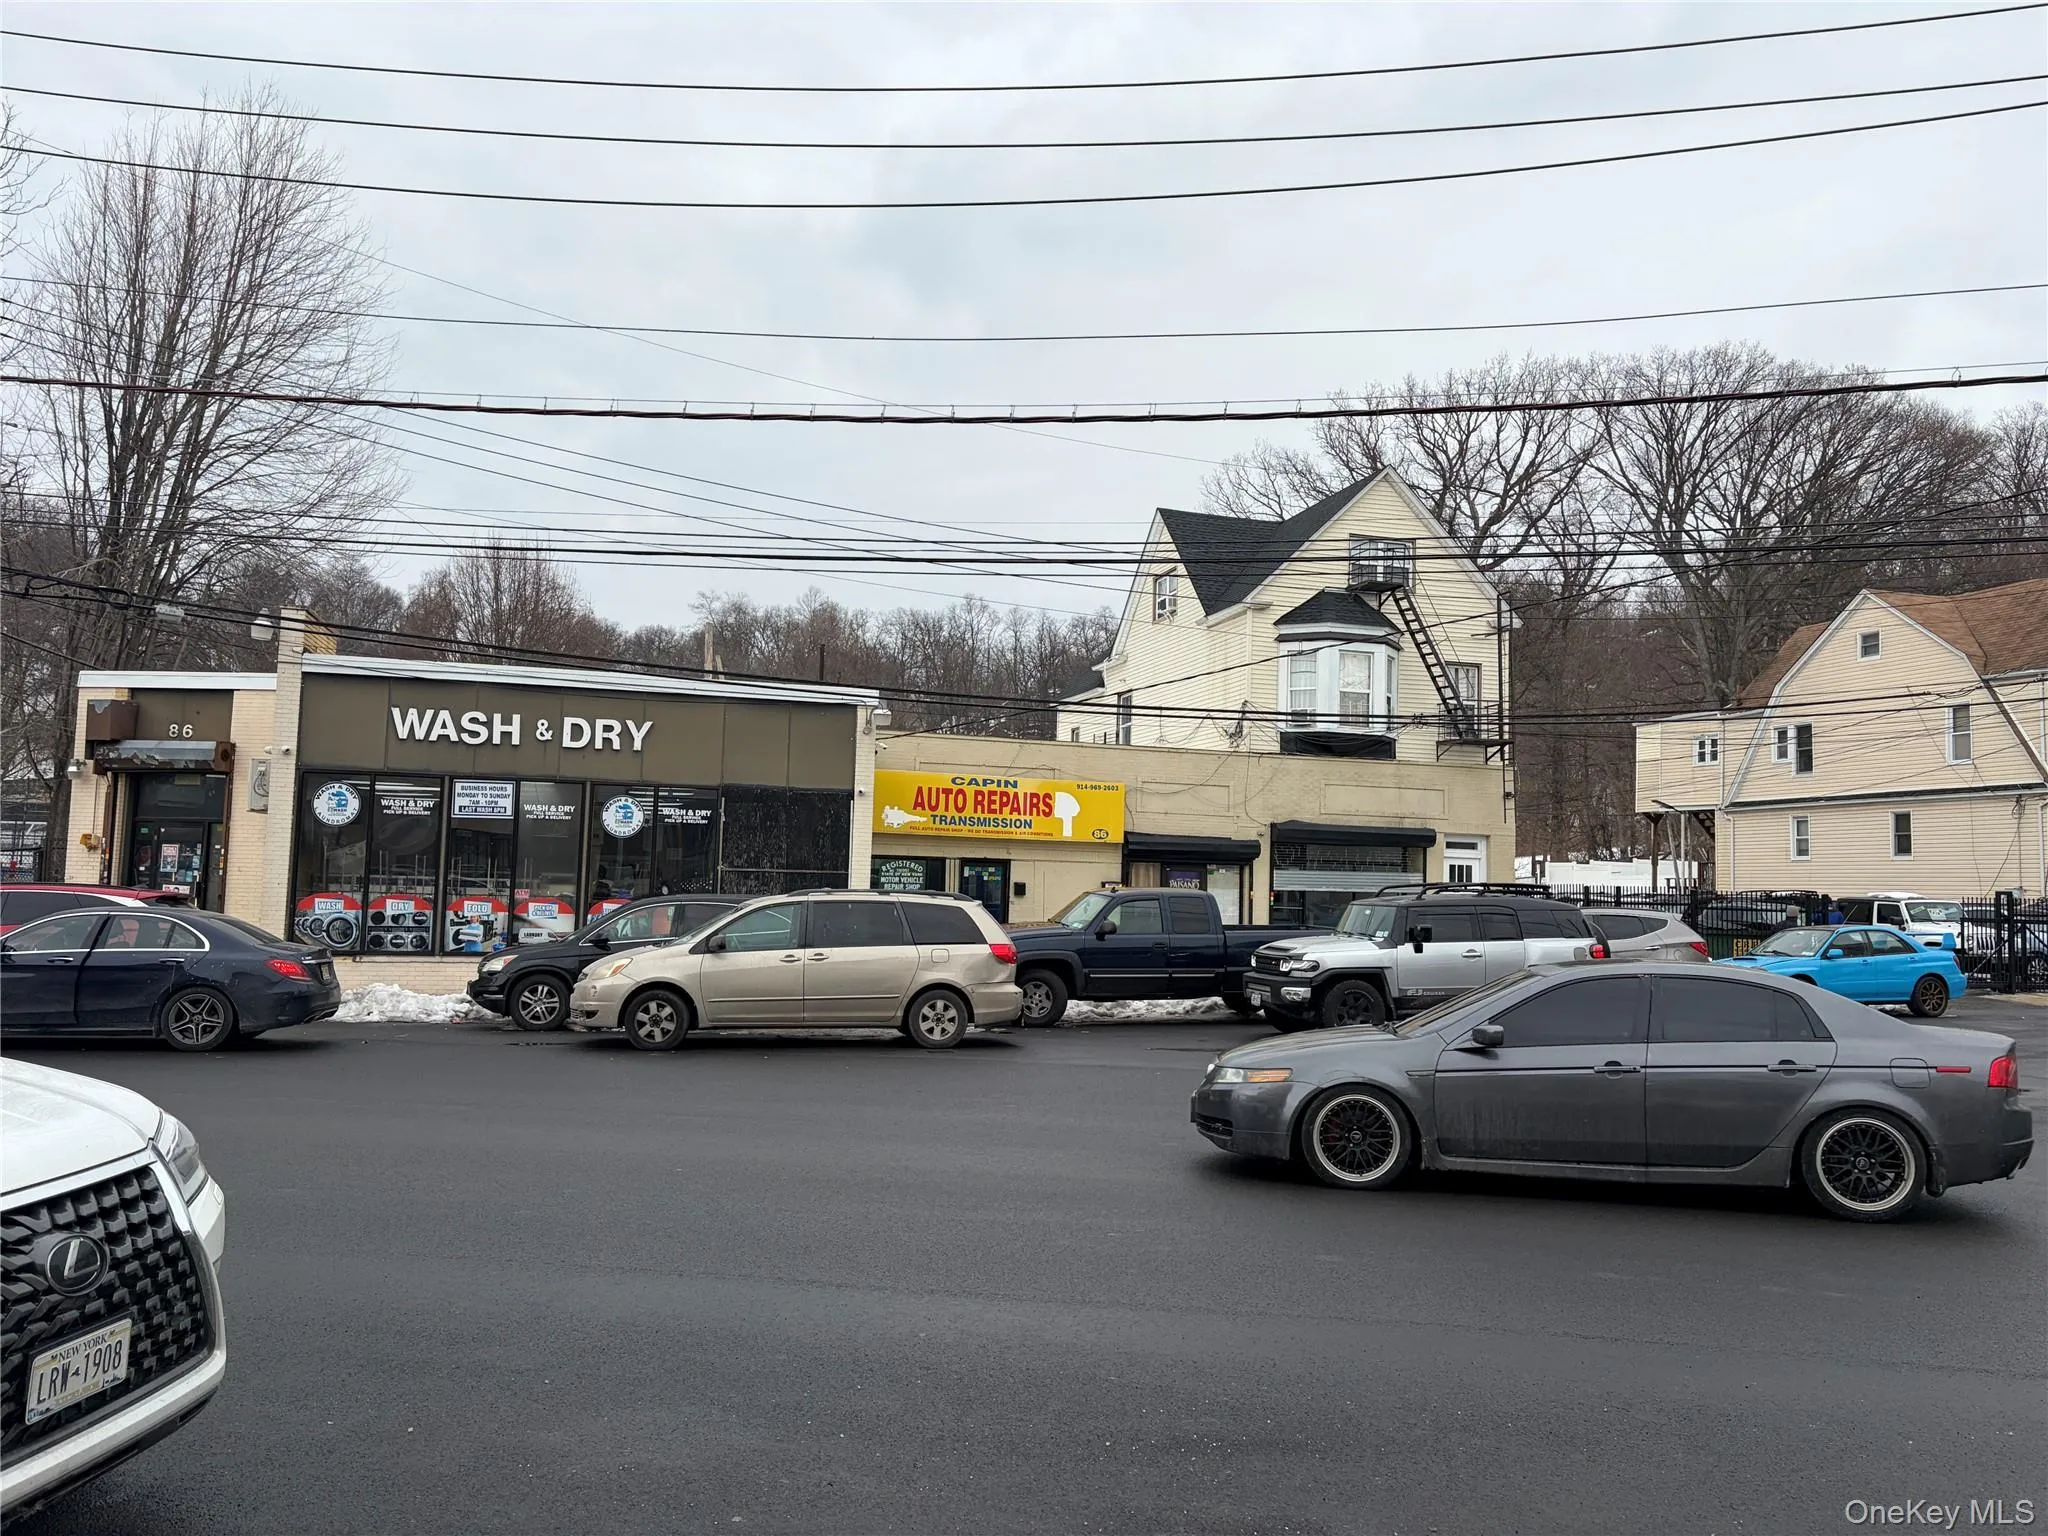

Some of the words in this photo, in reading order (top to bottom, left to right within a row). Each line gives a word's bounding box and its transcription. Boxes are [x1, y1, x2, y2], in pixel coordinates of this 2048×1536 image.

[168, 723, 193, 738] 86
[391, 706, 521, 746] WASH
[535, 719, 553, 741] &
[562, 716, 653, 751] DRY
[950, 776, 1018, 789] CAPIN
[316, 785, 336, 800] WASH
[345, 787, 358, 800] DRY
[604, 799, 622, 812] WASH
[631, 800, 642, 812] DRY
[912, 786, 967, 814] AUTO
[973, 789, 1053, 818] REPAIRS
[315, 806, 358, 824] LAUNDROMAT
[662, 808, 687, 816] WASH
[695, 809, 712, 817] DRY
[603, 818, 642, 836] LAUNDROMAT
[930, 814, 1033, 830] TRANSMISSION
[1093, 830, 1107, 839] 86
[881, 860, 924, 873] REGISTERED
[318, 901, 342, 911] WASH
[392, 902, 409, 911] DRY
[467, 904, 489, 913] FOLD
[58, 1343, 81, 1362] NEW
[83, 1332, 109, 1350] YORK
